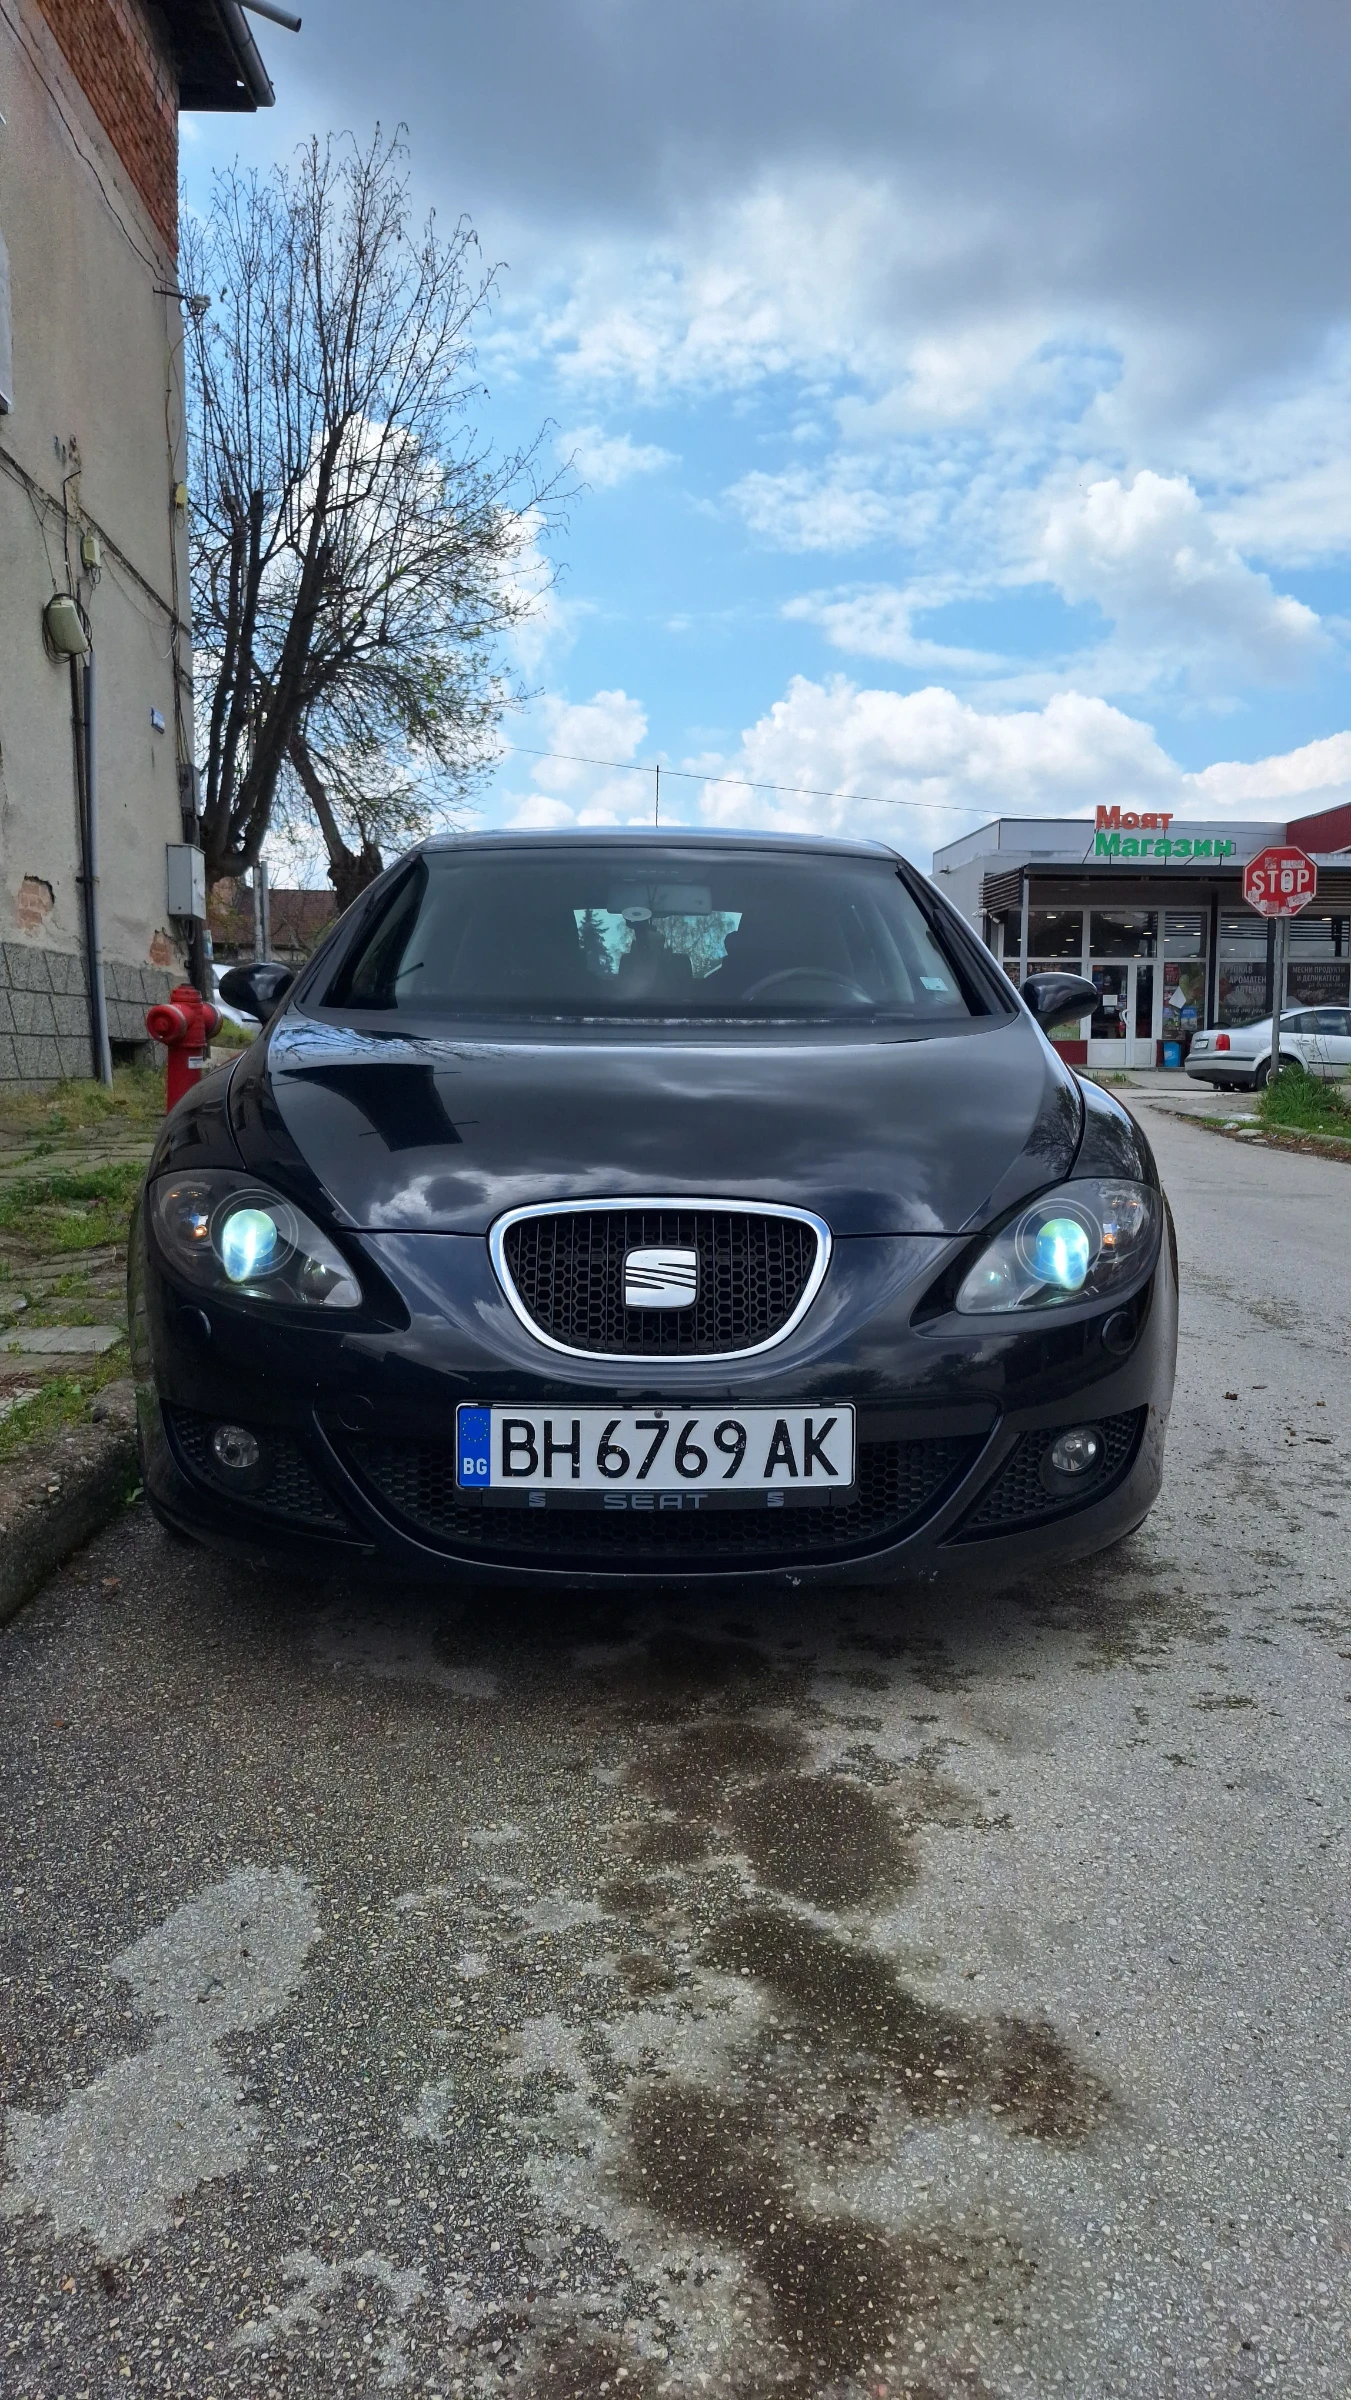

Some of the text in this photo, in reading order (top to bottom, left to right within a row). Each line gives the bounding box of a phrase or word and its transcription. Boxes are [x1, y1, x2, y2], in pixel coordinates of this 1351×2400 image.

[1096, 805, 1173, 830] Моят
[1095, 833, 1232, 858] Магазин
[1252, 870, 1310, 894] STOP
[1302, 974, 1341, 983] ДЕЛИКАТЕСИ
[1314, 966, 1346, 974] ПРОДУКТИ
[463, 1417, 839, 1479] BG BH 6769 AK
[604, 1493, 708, 1510] SEAT
